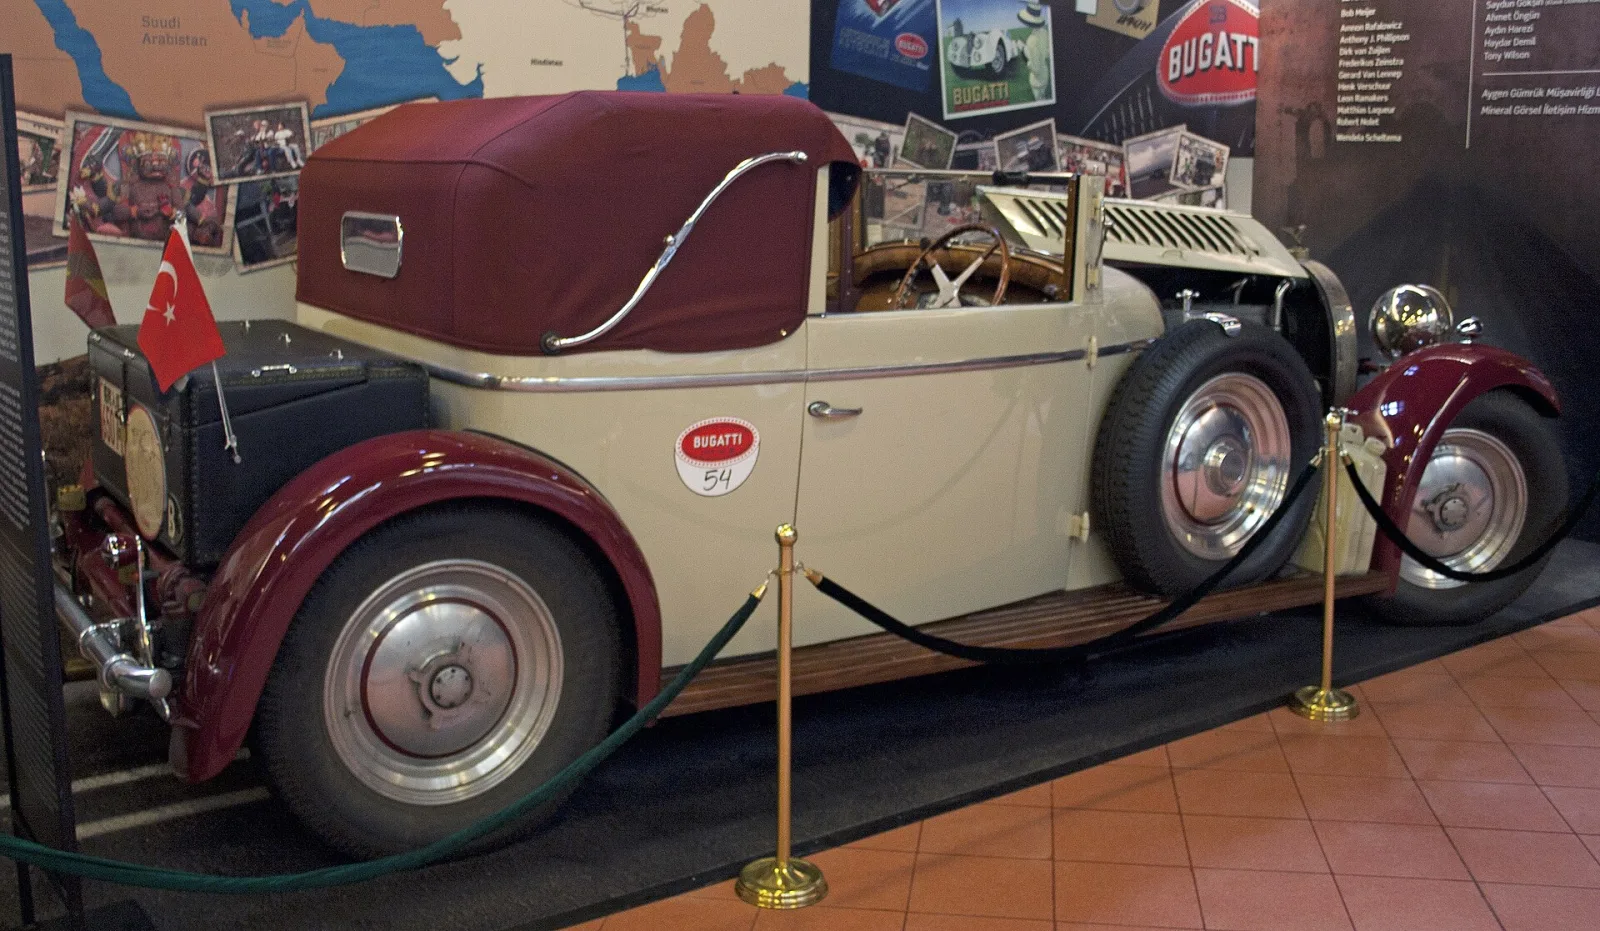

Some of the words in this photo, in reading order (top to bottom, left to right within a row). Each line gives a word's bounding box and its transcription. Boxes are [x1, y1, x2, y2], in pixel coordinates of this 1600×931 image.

[1484, 12, 1512, 22] Ahmet
[142, 33, 208, 47] Arabistan
[1484, 39, 1512, 49] Haydar
[1484, 52, 1502, 62] Tony
[1503, 50, 1530, 60] Wilson
[953, 82, 1009, 104] BUGATTI
[1509, 86, 1545, 98] Gümrük
[1480, 104, 1513, 115] Mineral
[1513, 103, 1542, 115] Görsel
[693, 432, 743, 449] BUGATTI
[703, 468, 732, 491] 54
